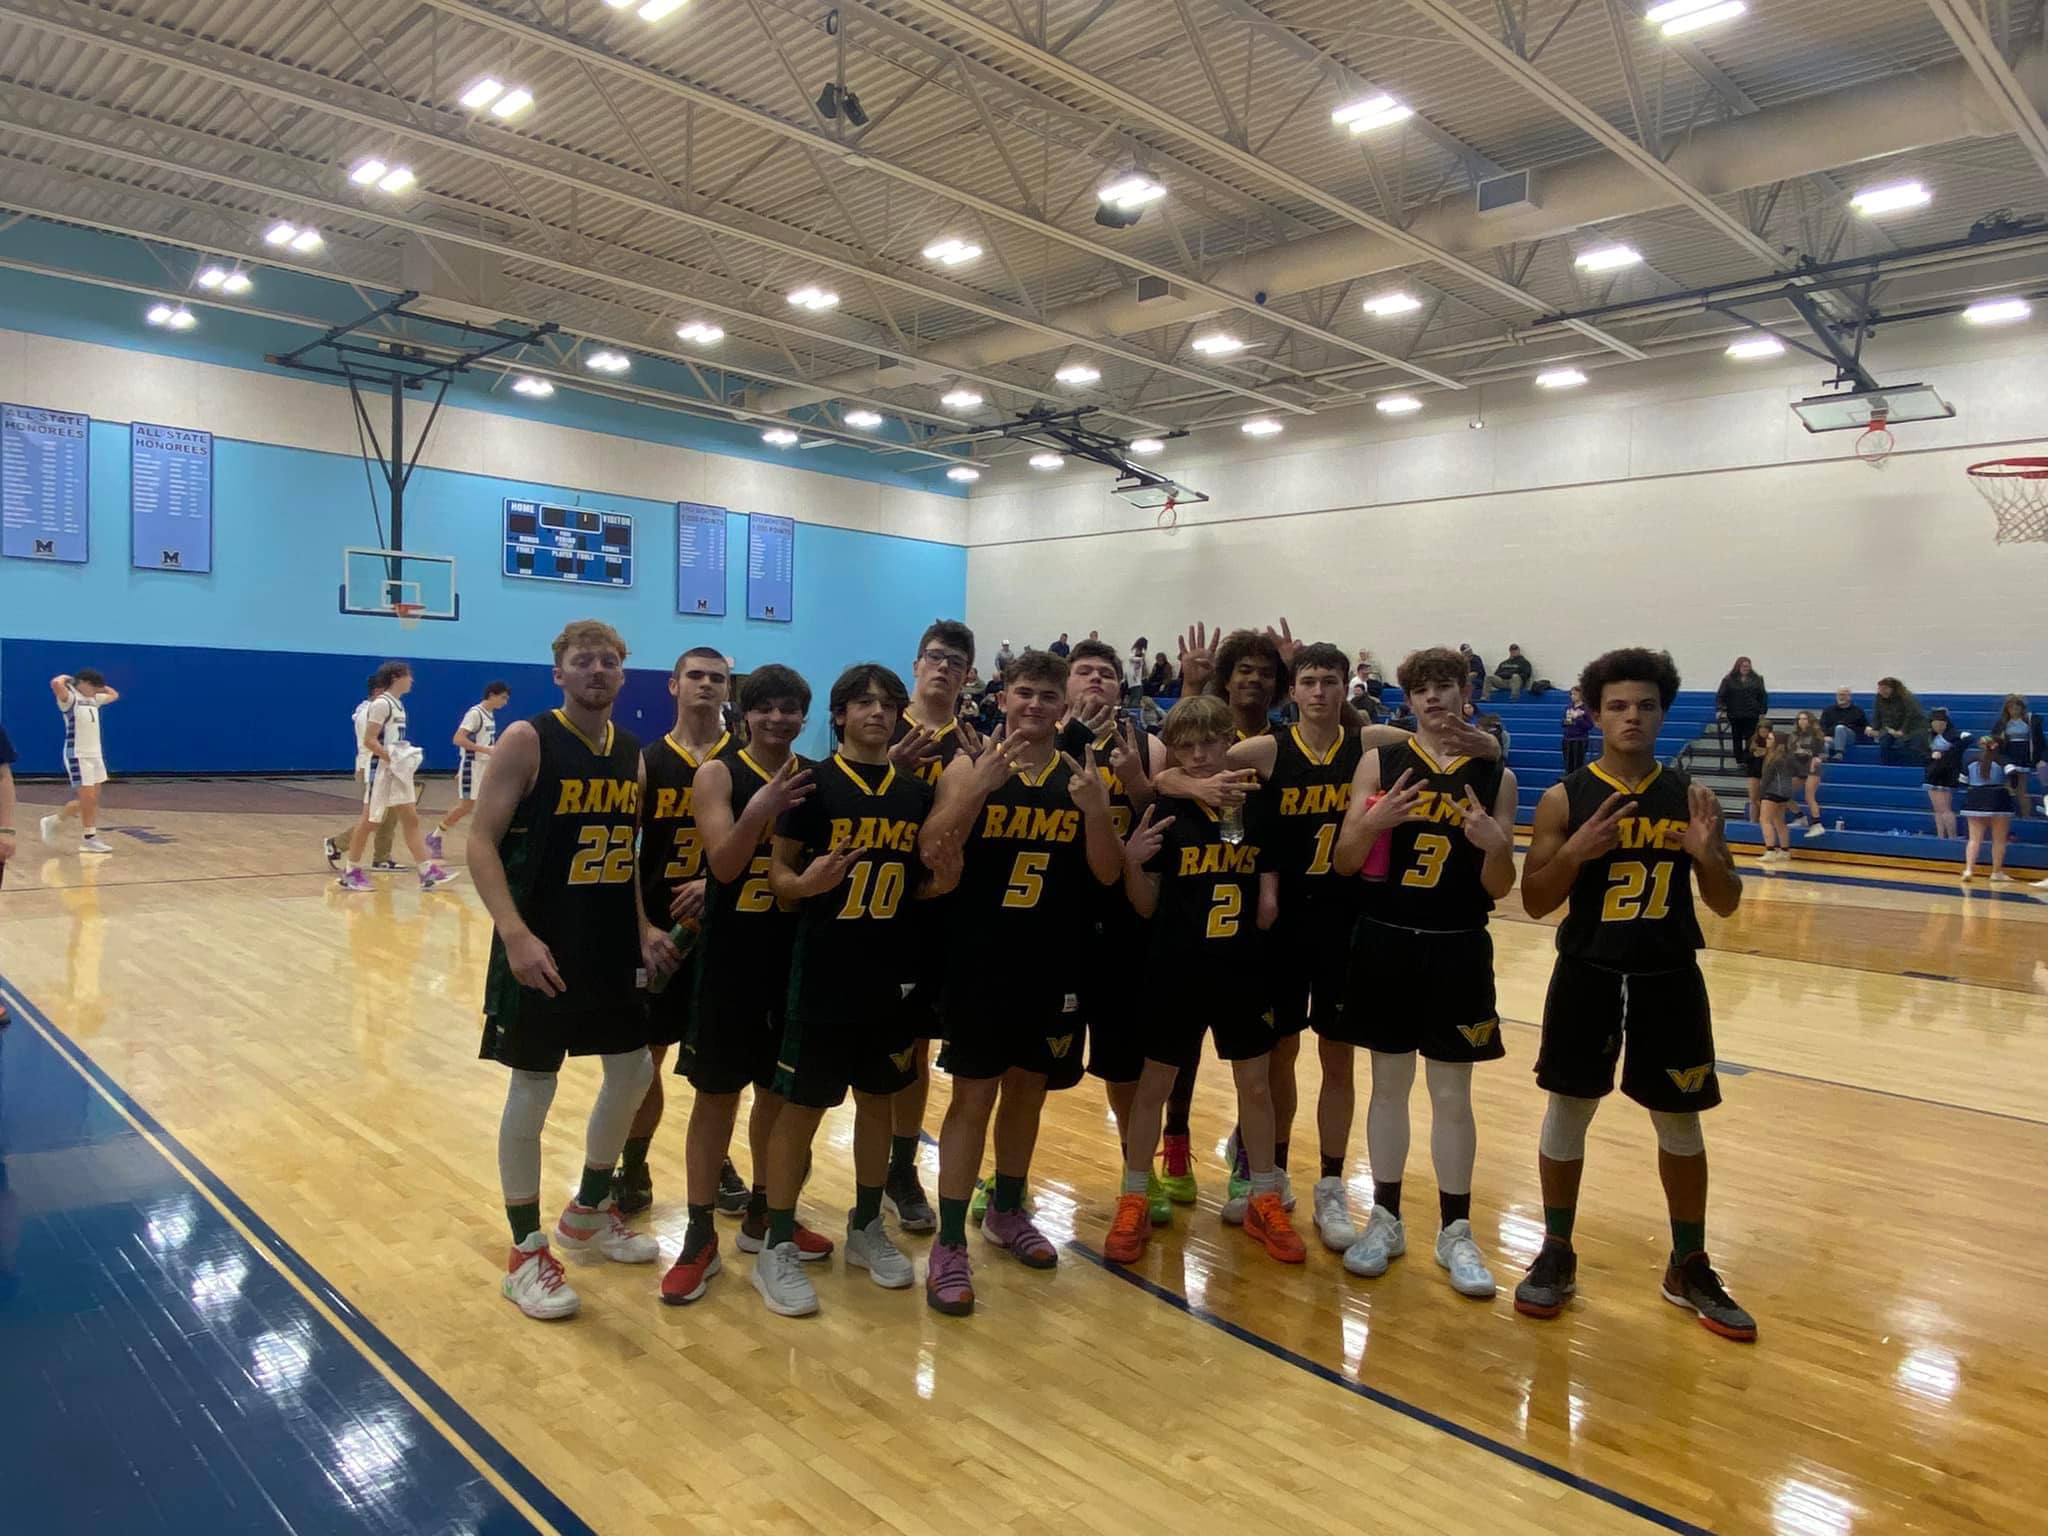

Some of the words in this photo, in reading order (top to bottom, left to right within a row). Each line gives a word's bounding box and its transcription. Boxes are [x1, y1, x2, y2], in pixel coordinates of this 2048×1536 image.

[4, 420, 85, 439] HONOREES
[6, 408, 34, 420] ALL
[39, 412, 85, 426] STATE
[136, 426, 161, 438] ALL
[167, 430, 208, 444] STATE
[135, 439, 208, 456] HONOREES
[511, 502, 536, 513] HOME
[603, 515, 631, 526] VISITOR
[555, 778, 640, 816] RAMS
[828, 817, 919, 853] RAMS
[982, 804, 1080, 843] RAMS
[1616, 815, 1690, 851] AMS
[567, 825, 634, 886] 22
[1177, 843, 1261, 877] RAMS
[1401, 833, 1452, 889] 3
[836, 861, 905, 920] 10
[1001, 851, 1050, 909] 5
[1601, 861, 1674, 922] 21
[1206, 884, 1242, 939] 2
